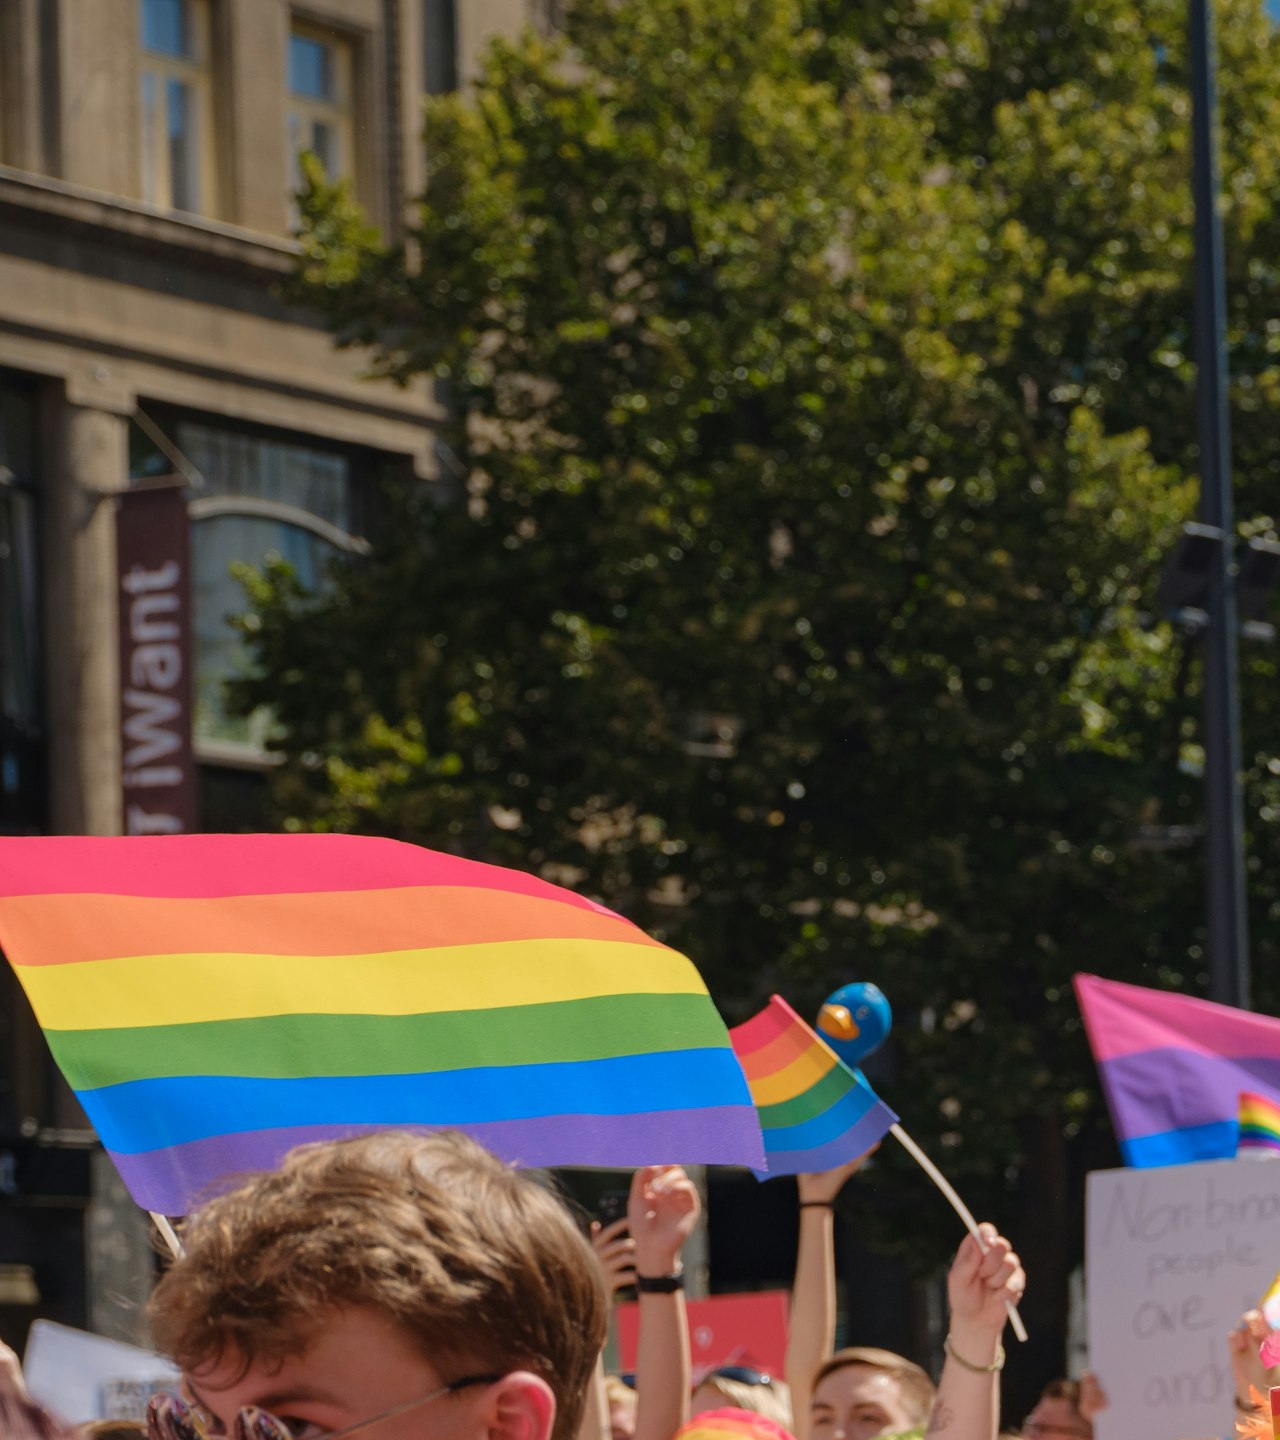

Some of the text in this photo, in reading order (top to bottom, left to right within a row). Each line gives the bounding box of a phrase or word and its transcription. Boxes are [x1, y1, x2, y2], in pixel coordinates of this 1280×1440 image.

[121, 558, 183, 787] iWant
[1146, 1234, 1260, 1289] people
[1142, 1337, 1223, 1408] and
